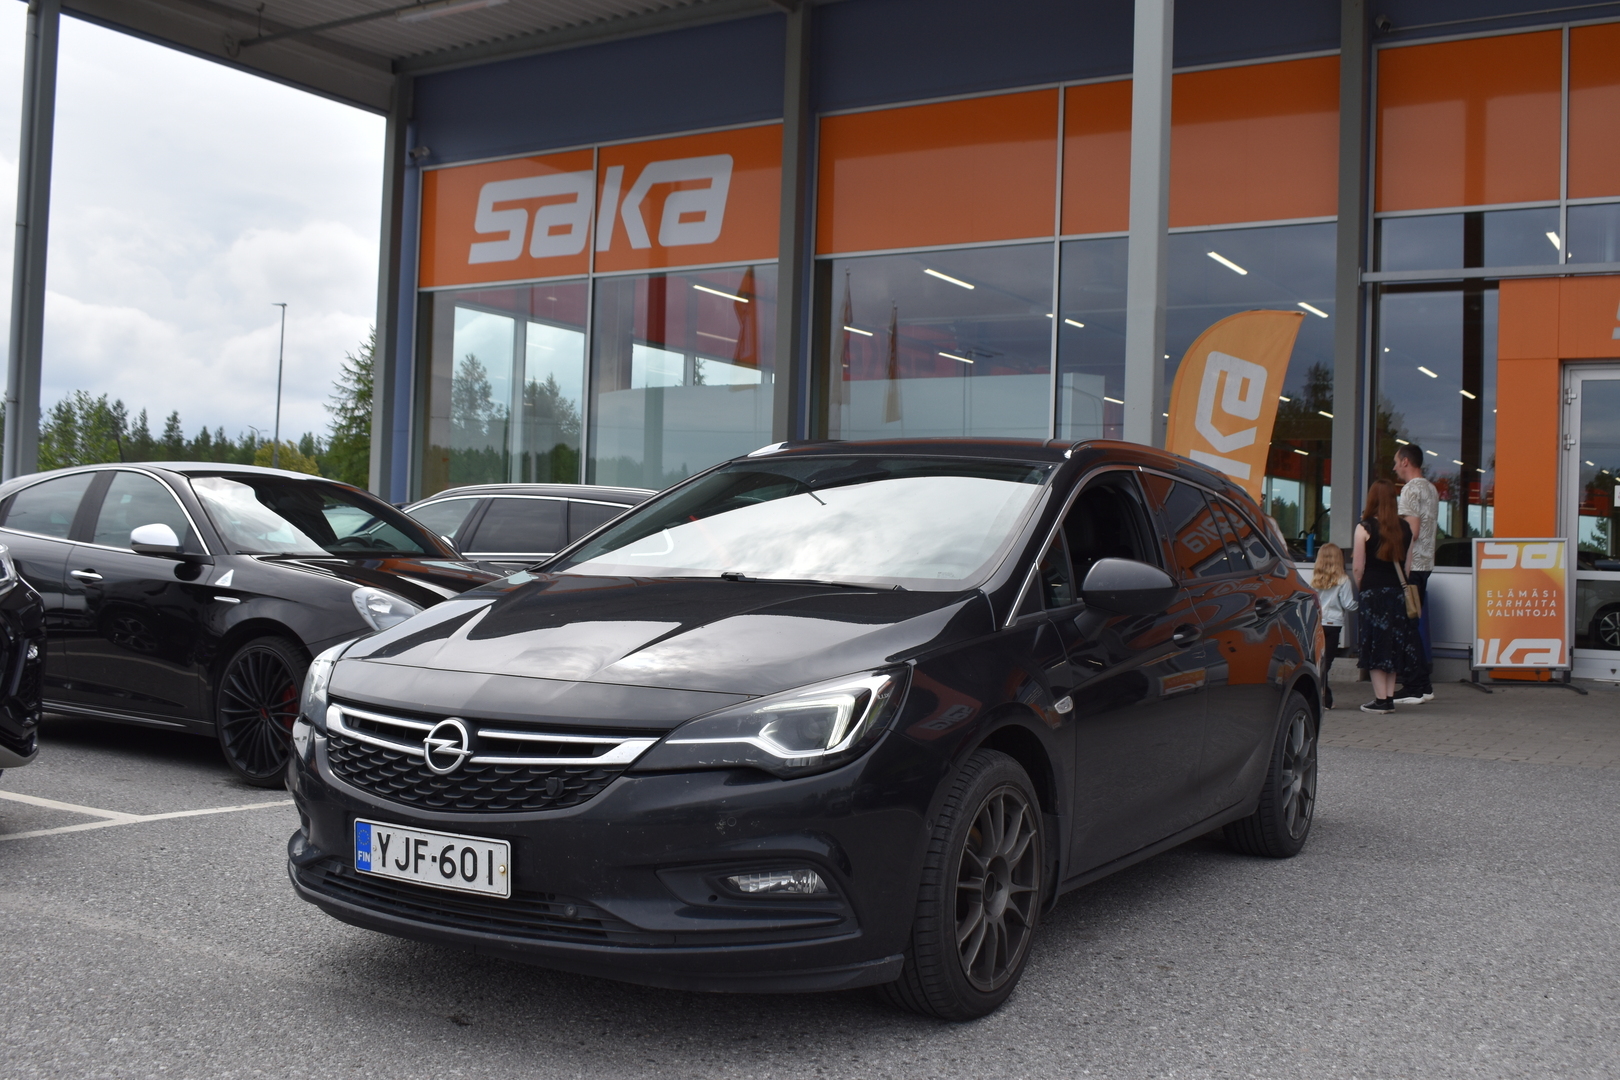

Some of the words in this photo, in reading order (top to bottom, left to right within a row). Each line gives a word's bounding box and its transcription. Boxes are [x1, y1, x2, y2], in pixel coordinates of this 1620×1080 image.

[1486, 588, 1556, 598] ELÄMÄSI
[1486, 600, 1557, 608] PARHAITA
[1486, 609, 1557, 617] VALINTOJA
[357, 850, 371, 863] FIN
[377, 832, 493, 885] YJF-601
